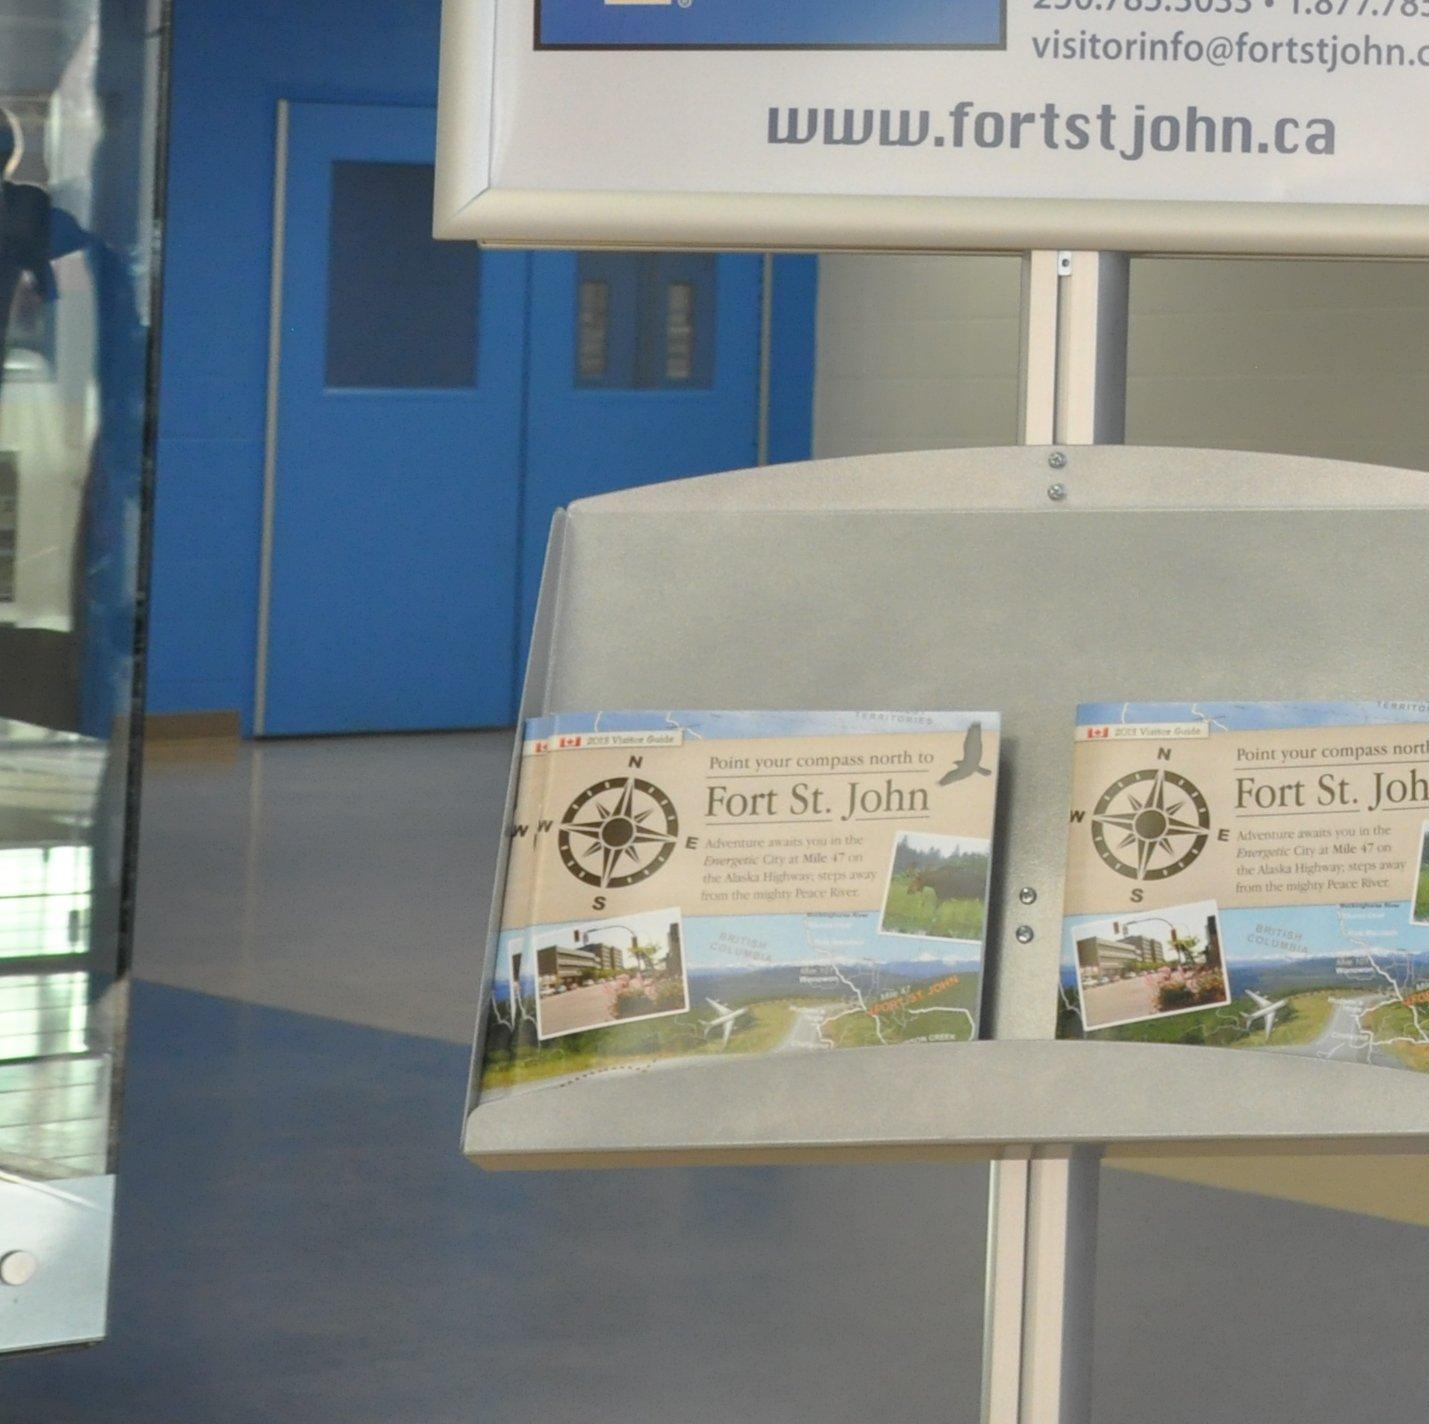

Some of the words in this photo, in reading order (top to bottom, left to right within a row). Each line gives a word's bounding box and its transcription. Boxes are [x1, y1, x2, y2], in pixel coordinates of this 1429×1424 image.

[766, 102, 1336, 161] www.fortstjohn.ca
[1157, 747, 1172, 760] N
[1236, 747, 1276, 761] Point
[1281, 746, 1317, 764] your
[1321, 743, 1388, 762] compass
[628, 755, 643, 768] N
[709, 756, 751, 770] Point
[755, 757, 791, 773] your
[796, 754, 865, 771] compass
[870, 751, 913, 765] north
[918, 752, 935, 764] to
[1235, 777, 1306, 809] Fort
[1317, 773, 1359, 806] St.
[705, 785, 778, 817] Fort
[789, 782, 832, 815] St.
[840, 779, 931, 821] John
[1069, 810, 1086, 823] W
[1217, 828, 1230, 842] E
[1237, 829, 1295, 841] Adventure
[685, 836, 699, 850] E
[705, 837, 765, 849] Adventure
[1332, 844, 1358, 854] Mile
[1130, 888, 1144, 902] S
[592, 896, 607, 911] S
